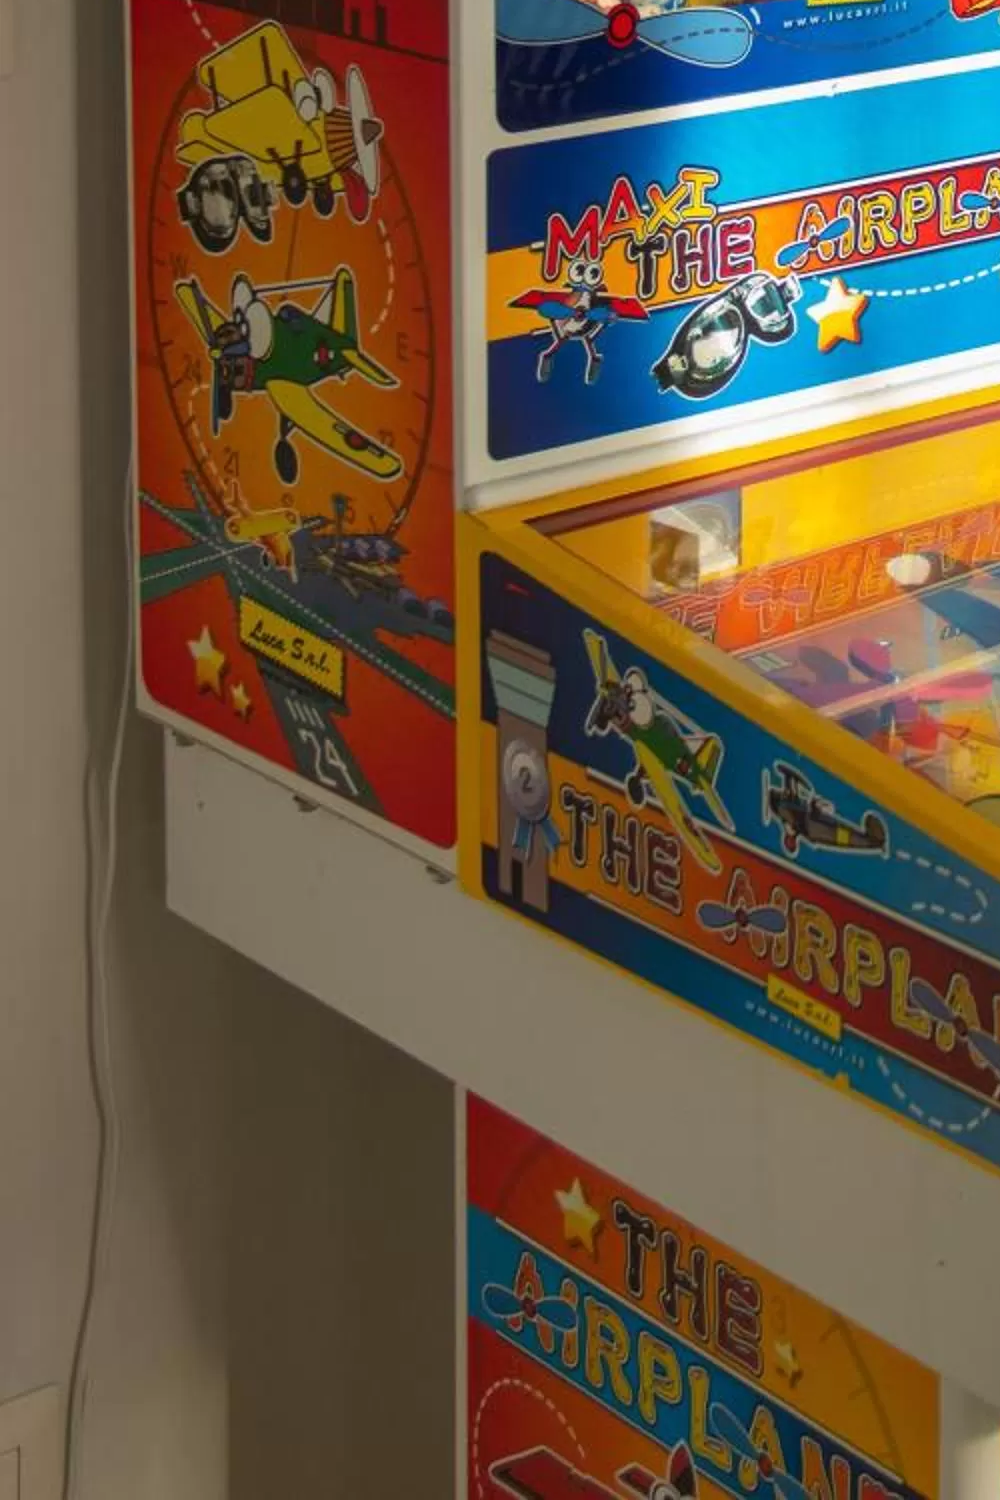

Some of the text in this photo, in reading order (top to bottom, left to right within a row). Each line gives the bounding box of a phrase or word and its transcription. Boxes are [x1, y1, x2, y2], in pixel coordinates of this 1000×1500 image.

[783, 1, 908, 29] www.lucasrl.it
[543, 164, 721, 281] MAXI
[627, 213, 759, 299] THE
[248, 619, 288, 657] Luca
[298, 728, 360, 796] 24
[519, 766, 533, 793] 2
[559, 782, 684, 917] THE
[612, 1199, 763, 1378] THE
[482, 1251, 908, 1500] AIRPLAN
